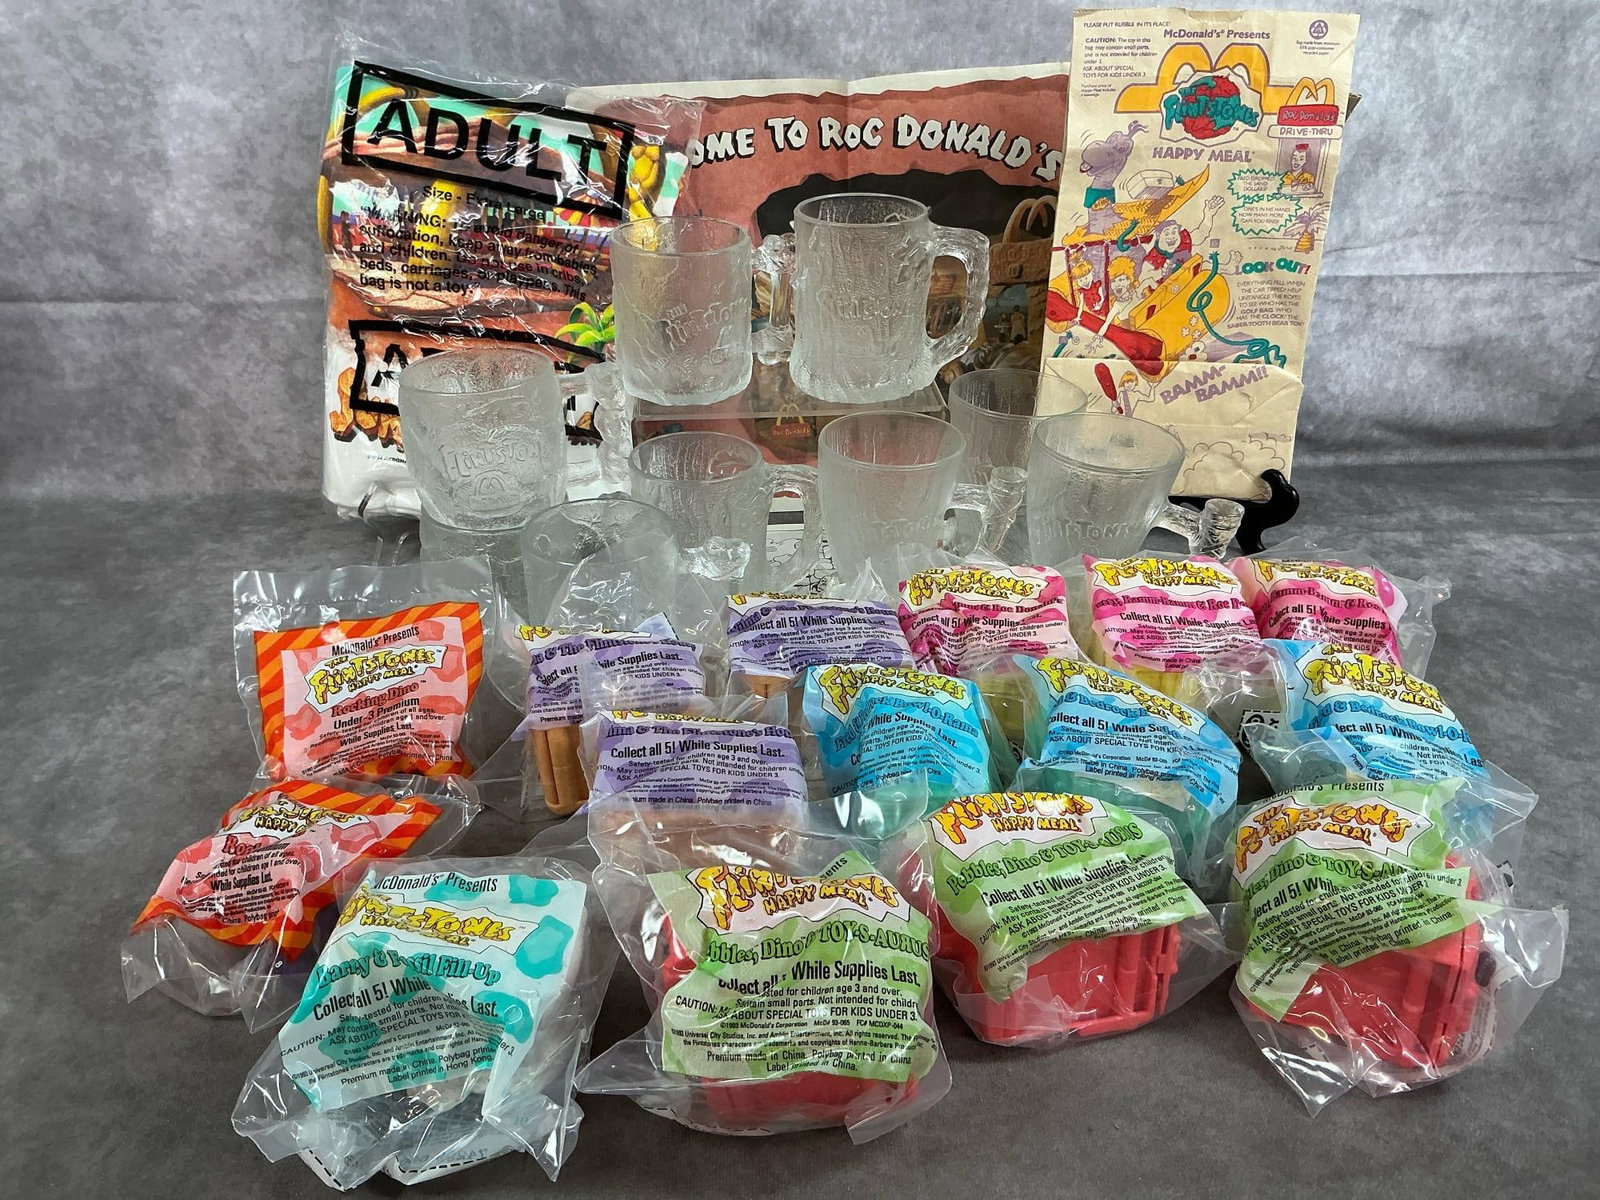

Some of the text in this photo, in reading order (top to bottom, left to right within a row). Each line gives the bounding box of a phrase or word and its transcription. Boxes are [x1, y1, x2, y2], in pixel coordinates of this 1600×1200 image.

[1227, 30, 1270, 39] Presents
[367, 97, 609, 193] ADULT
[767, 114, 809, 152] TO
[895, 113, 1062, 182] DONALD'S
[1153, 146, 1252, 163] HAPPY MEAL
[422, 185, 453, 201] Size
[516, 227, 563, 250] danger
[564, 242, 579, 255] of
[389, 242, 452, 262] children.
[551, 268, 585, 286] cribs,
[1235, 258, 1311, 275] LOOK OUT!
[359, 257, 586, 301] beds, carriages, This
[359, 274, 442, 293] bag is not a
[1160, 365, 1226, 405] BAMM-
[1195, 365, 1269, 403] BAMM!!
[1144, 575, 1181, 586] HAPPY
[776, 615, 866, 629] all While Supplies
[911, 614, 950, 630] Collect all
[1120, 612, 1151, 623] Collect
[1152, 614, 1162, 624] all
[1175, 616, 1201, 627] While
[1292, 604, 1385, 630] all Supplies
[332, 626, 419, 656] McDonald's Presents
[617, 650, 682, 666] Supplies Last.
[309, 648, 436, 704] FLINTSTONES
[348, 666, 414, 692] HAPPY MEAL
[331, 682, 419, 718] Rocking Dino
[1399, 691, 1442, 713] MEAL
[333, 698, 420, 730] Under-3 Premium
[1082, 714, 1146, 733] all 5! While
[339, 723, 414, 748] While Supplies Last.
[868, 712, 957, 749] While Supplies Last.
[1066, 736, 1092, 744] ABOUT
[1094, 737, 1127, 746] SPECIAL
[611, 740, 785, 759] Collect all 5! While Supplies Last.
[255, 817, 297, 832] HAPPY
[991, 817, 1078, 832] HAPPY MEAL
[1323, 822, 1371, 846] MEAL
[1002, 853, 1038, 875] Dino
[446, 872, 498, 892] Presents
[1023, 883, 1036, 899] all
[1036, 878, 1049, 897] 5!
[1050, 871, 1081, 892] While
[764, 884, 869, 915] HAPPY MEAL
[1271, 884, 1303, 908] all 5!
[1303, 888, 1396, 931] SPECIAL TOYS FOR KIDS
[760, 934, 802, 961] Dino
[436, 955, 501, 987] Fill-Up
[791, 960, 921, 987] While Supplies Last.
[354, 989, 371, 1009] all
[375, 983, 390, 1003] 5!
[392, 976, 431, 998] While
[471, 997, 499, 1019] Last.
[767, 995, 889, 1008] small Not intended for
[801, 985, 902, 995] children age and over.
[380, 1014, 444, 1035] SPECIAL TOYS
[731, 1007, 907, 1020] ABOUT SPECIAL KIDS UNDER
[470, 1055, 494, 1067] Kong.
